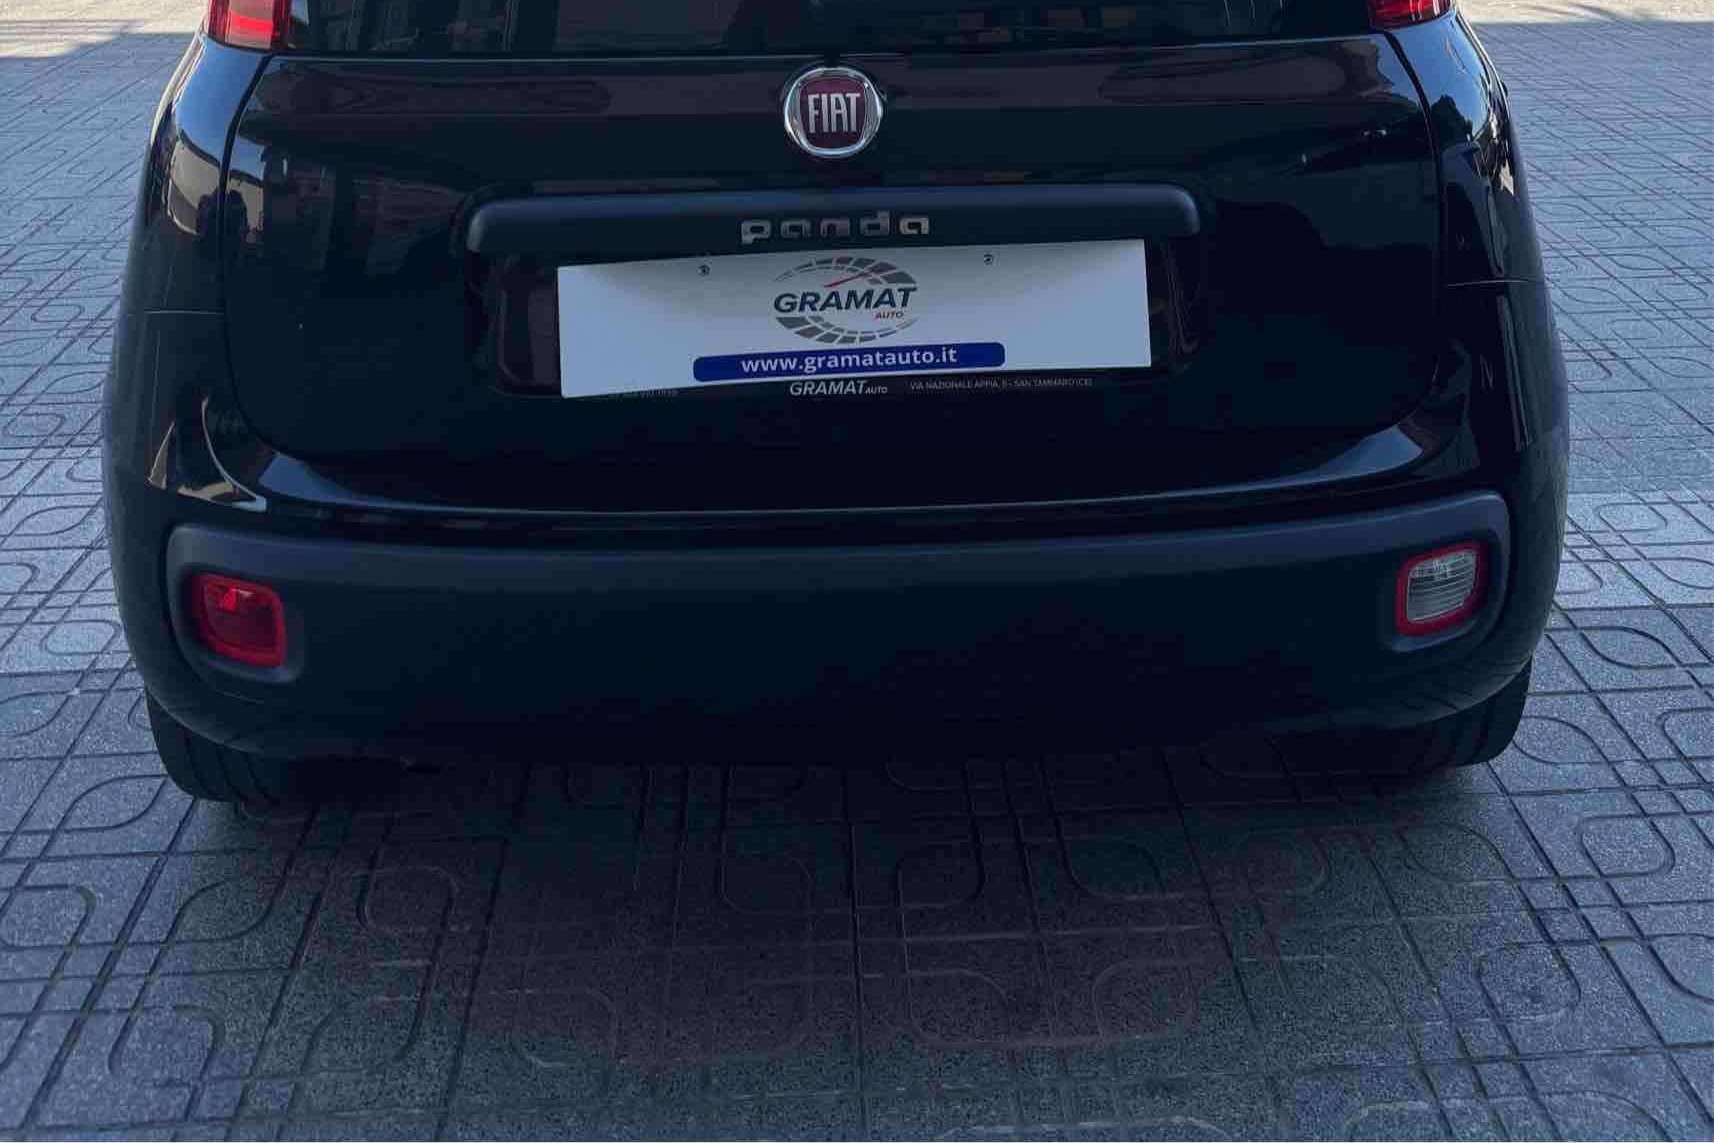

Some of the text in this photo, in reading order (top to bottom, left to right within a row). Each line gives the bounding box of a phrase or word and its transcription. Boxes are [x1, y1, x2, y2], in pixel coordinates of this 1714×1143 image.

[807, 92, 861, 134] FIAT
[740, 210, 931, 245] panda
[773, 286, 918, 314] GRAMAT
[875, 310, 905, 320] AUTO
[741, 346, 958, 375] www.gramatauto.it
